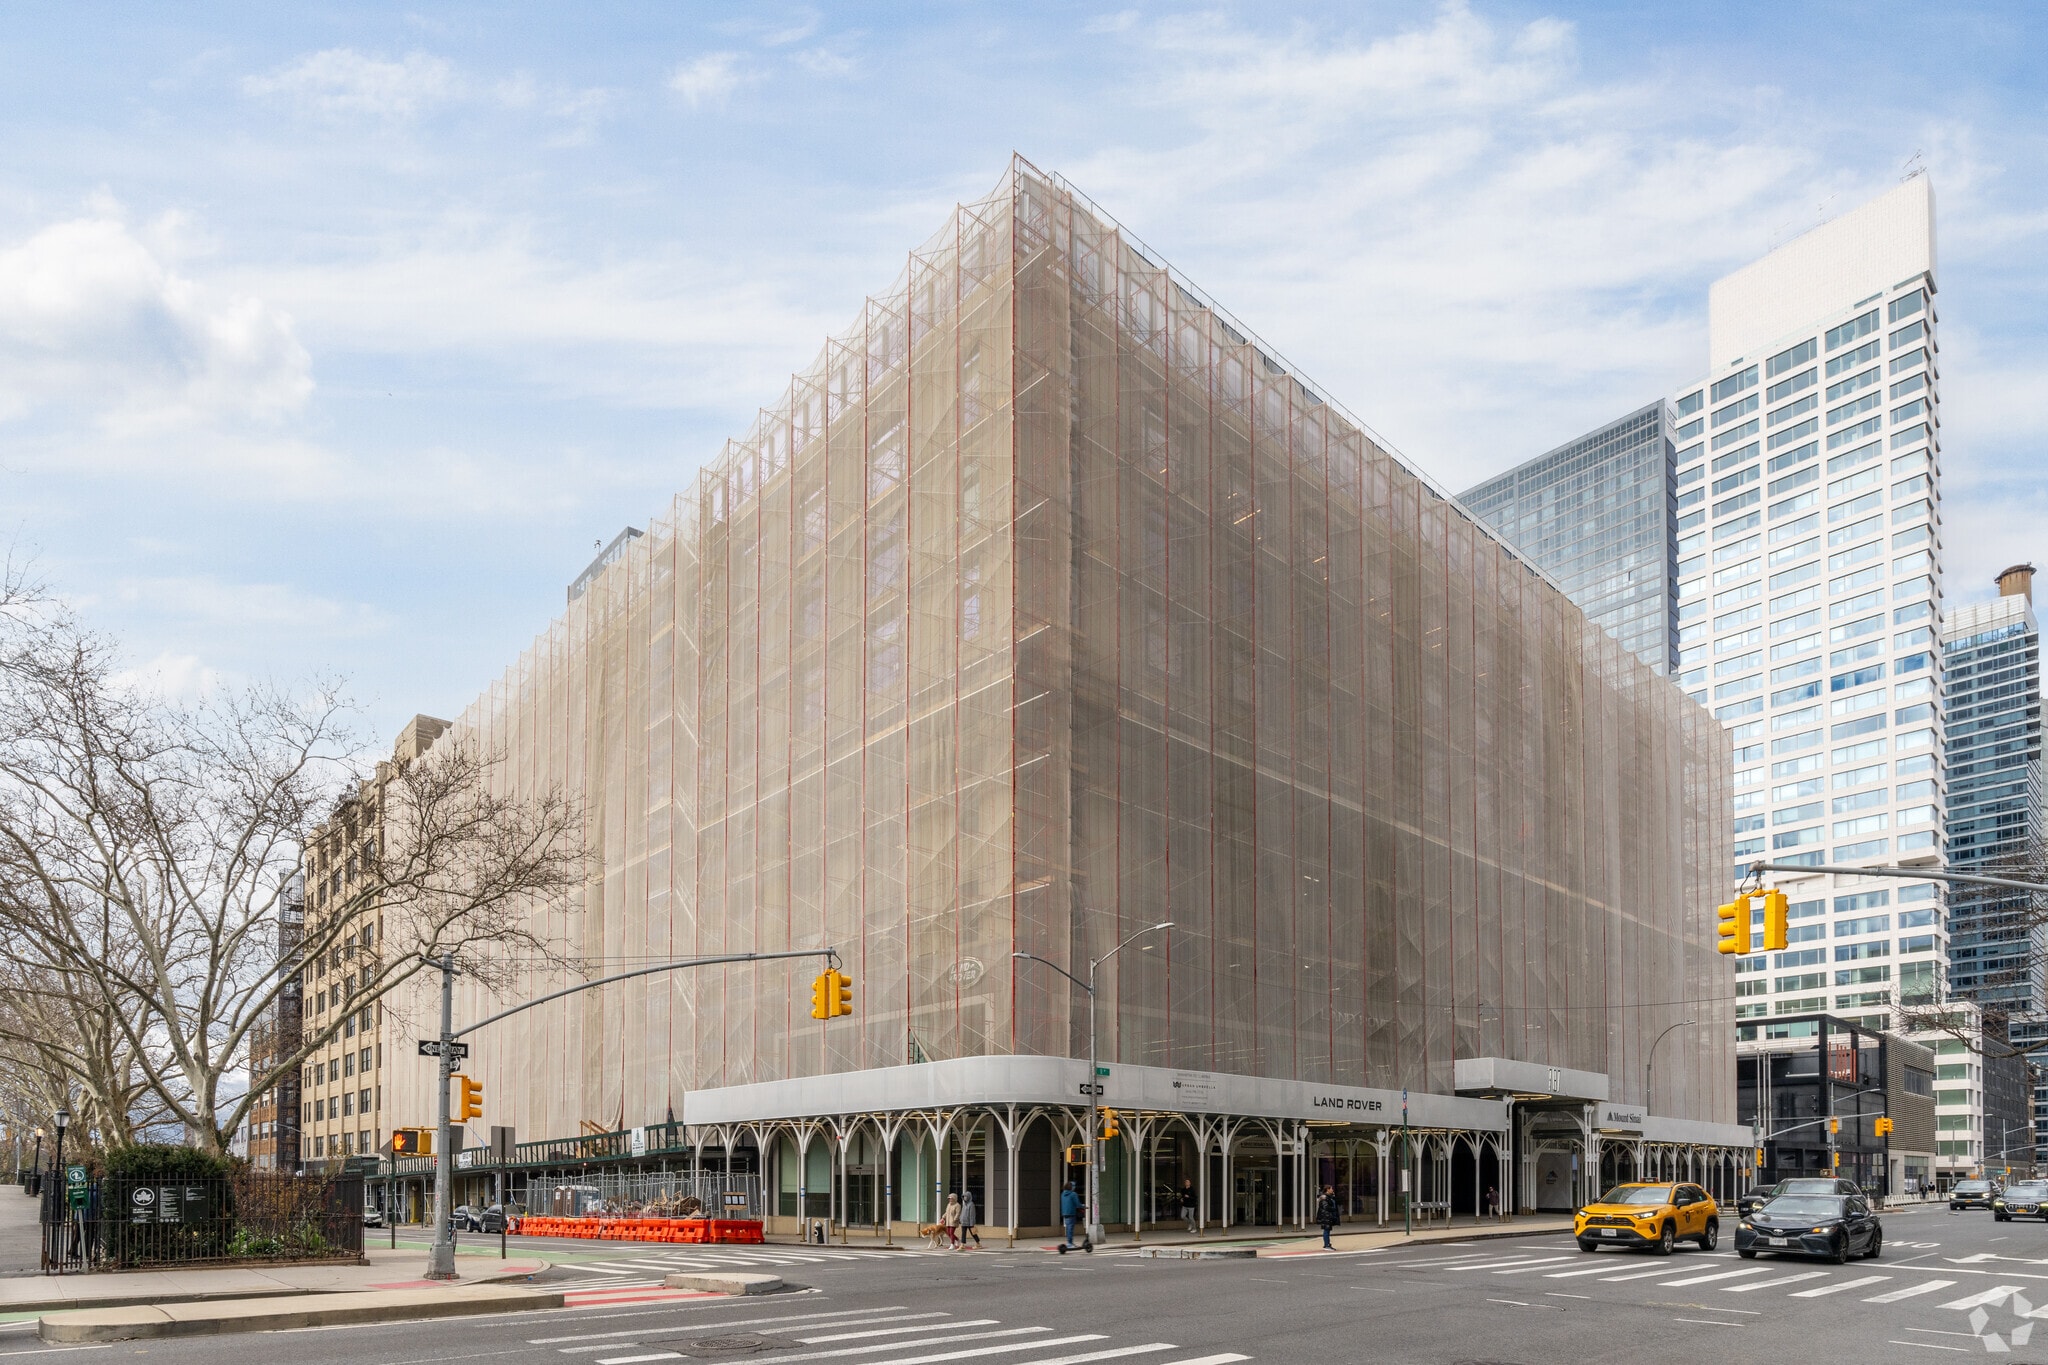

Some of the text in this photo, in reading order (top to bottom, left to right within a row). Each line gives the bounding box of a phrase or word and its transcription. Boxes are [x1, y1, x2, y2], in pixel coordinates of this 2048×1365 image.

[1313, 1096, 1382, 1111] LAND ROVER
[1613, 1112, 1641, 1123] Mount Sinai
